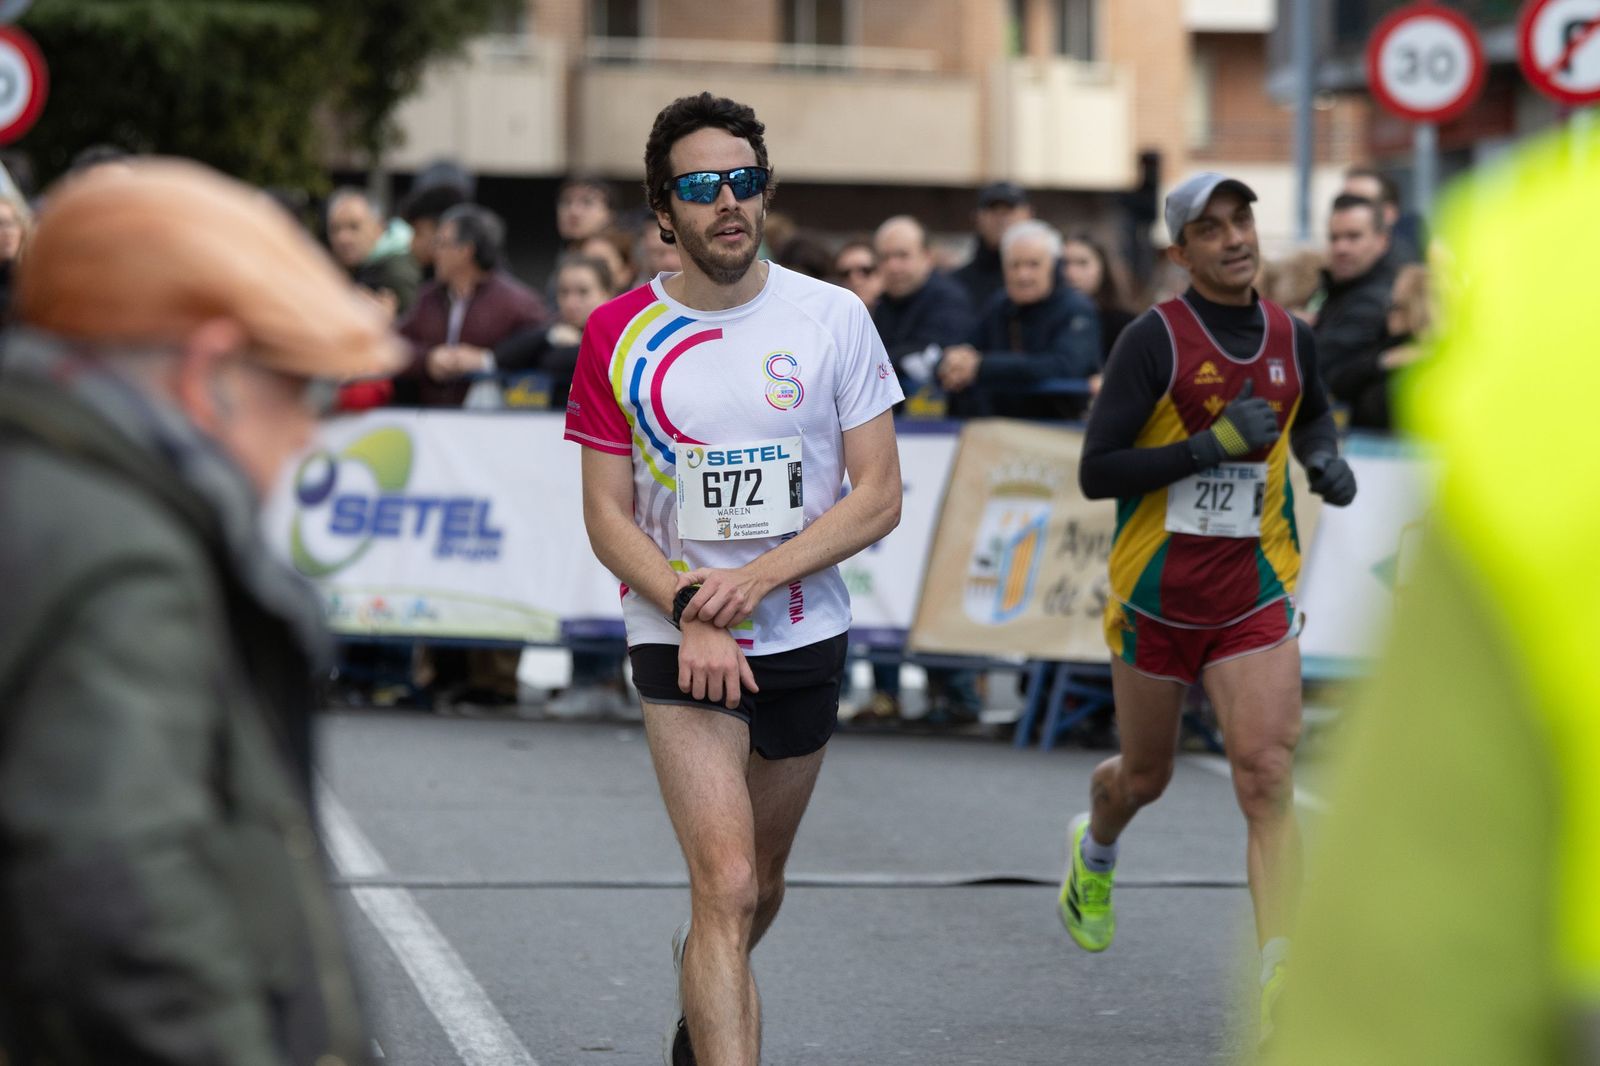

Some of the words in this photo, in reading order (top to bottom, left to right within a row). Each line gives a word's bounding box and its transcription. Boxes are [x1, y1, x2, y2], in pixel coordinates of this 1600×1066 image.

[1395, 44, 1458, 85] 30
[707, 445, 790, 466] SETEL
[702, 468, 764, 508] 672
[1195, 482, 1234, 511] 212
[329, 495, 502, 538] SETEL
[717, 507, 751, 516] WAREIN
[733, 521, 769, 529] Ayuntamiento
